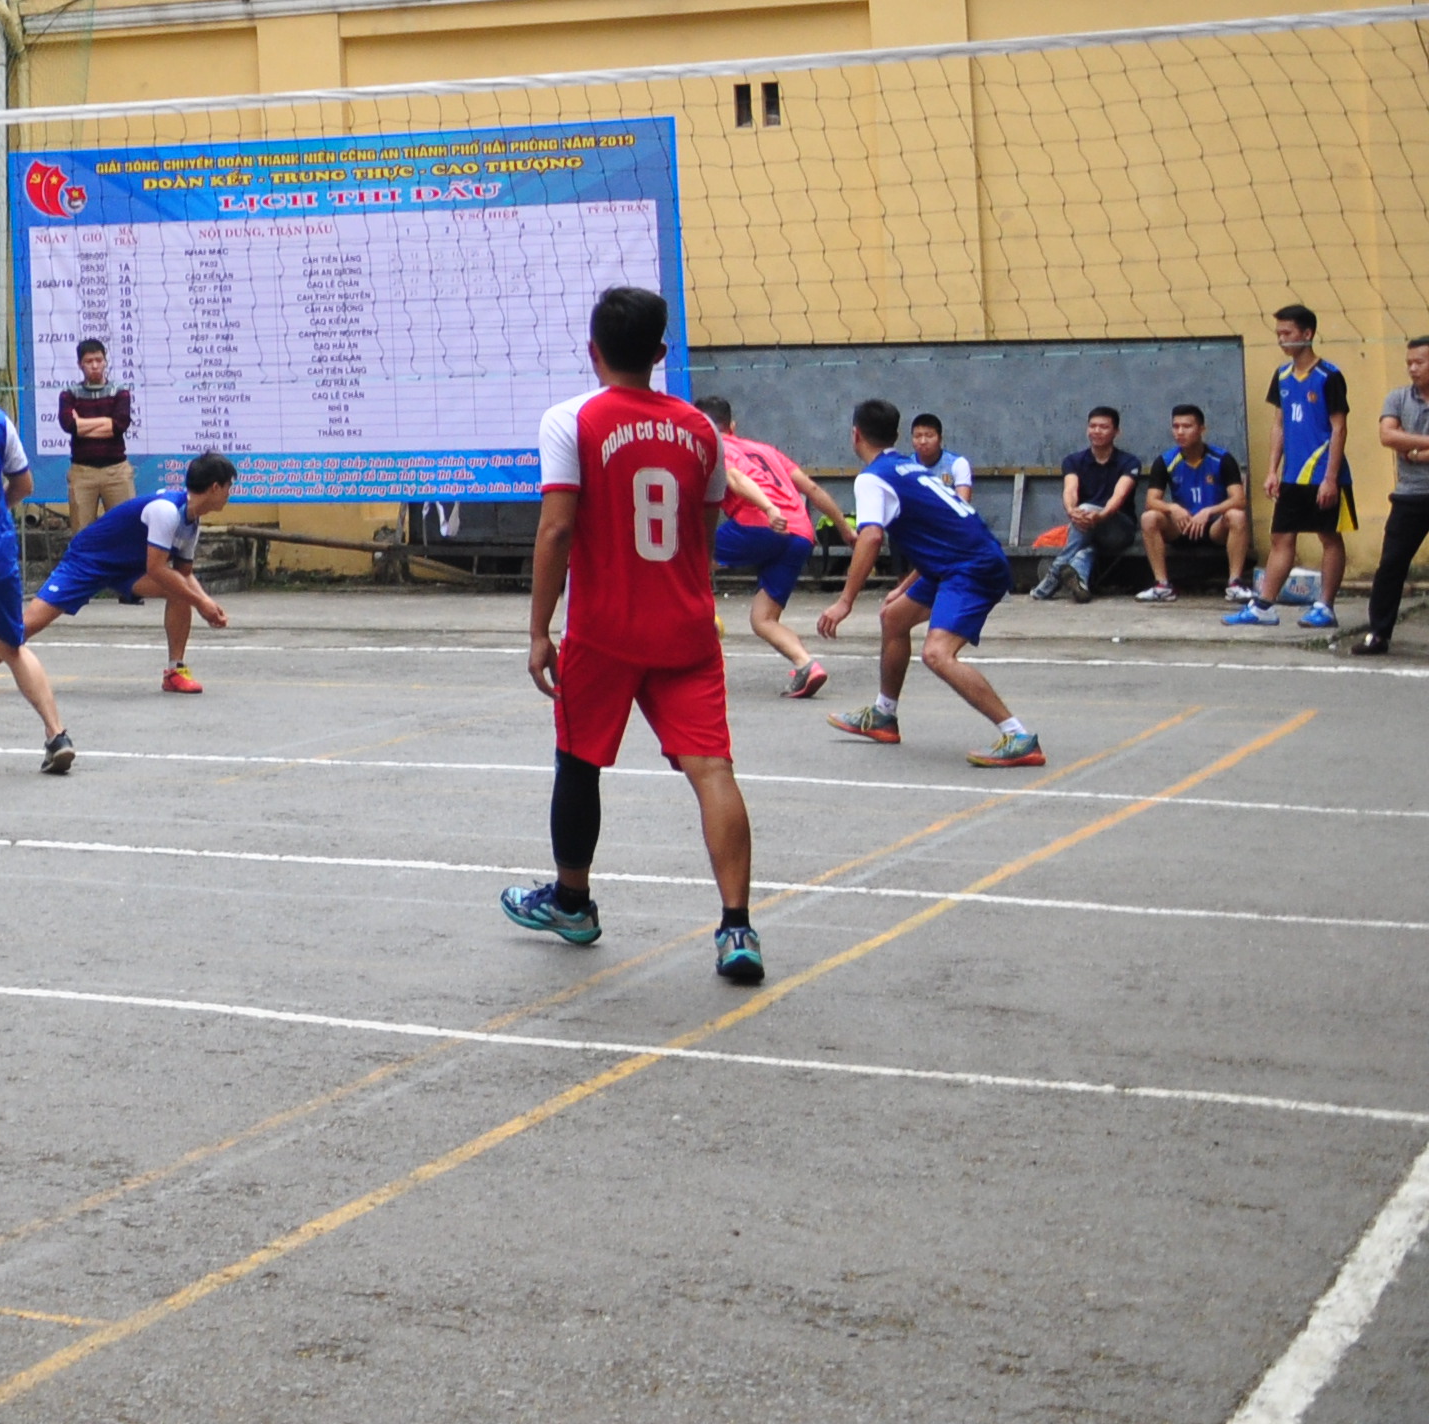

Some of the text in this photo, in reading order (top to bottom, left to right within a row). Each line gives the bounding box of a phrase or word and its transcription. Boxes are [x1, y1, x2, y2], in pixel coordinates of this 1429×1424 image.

[270, 168, 346, 185] TRUNG
[431, 160, 480, 176] CAO
[219, 179, 502, 213] LỊCH THI ĐẤU
[601, 418, 694, 467] ĐOÀN CƠ SỞ PK
[633, 467, 679, 561] 8
